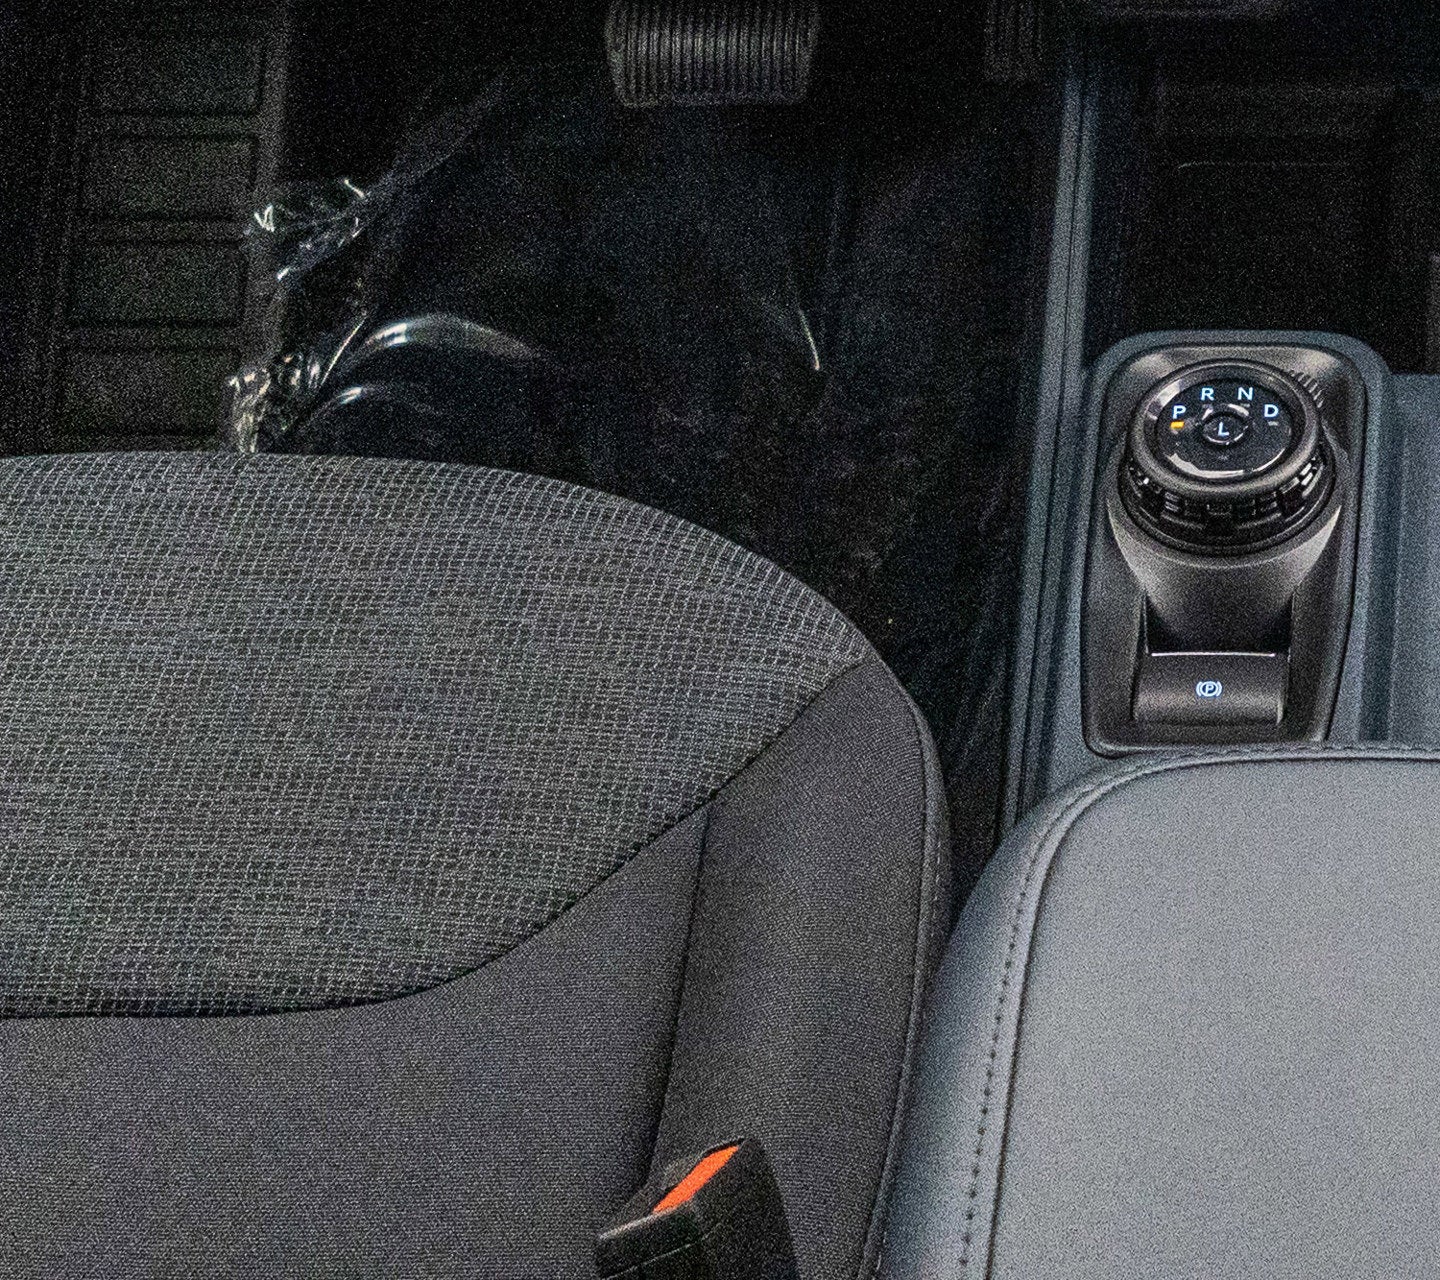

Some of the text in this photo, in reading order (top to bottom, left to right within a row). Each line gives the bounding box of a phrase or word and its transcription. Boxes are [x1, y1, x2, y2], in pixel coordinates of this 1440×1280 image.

[1200, 386, 1254, 401] R N
[1172, 405, 1187, 420] P
[1263, 404, 1280, 418] D
[1217, 421, 1230, 437] L
